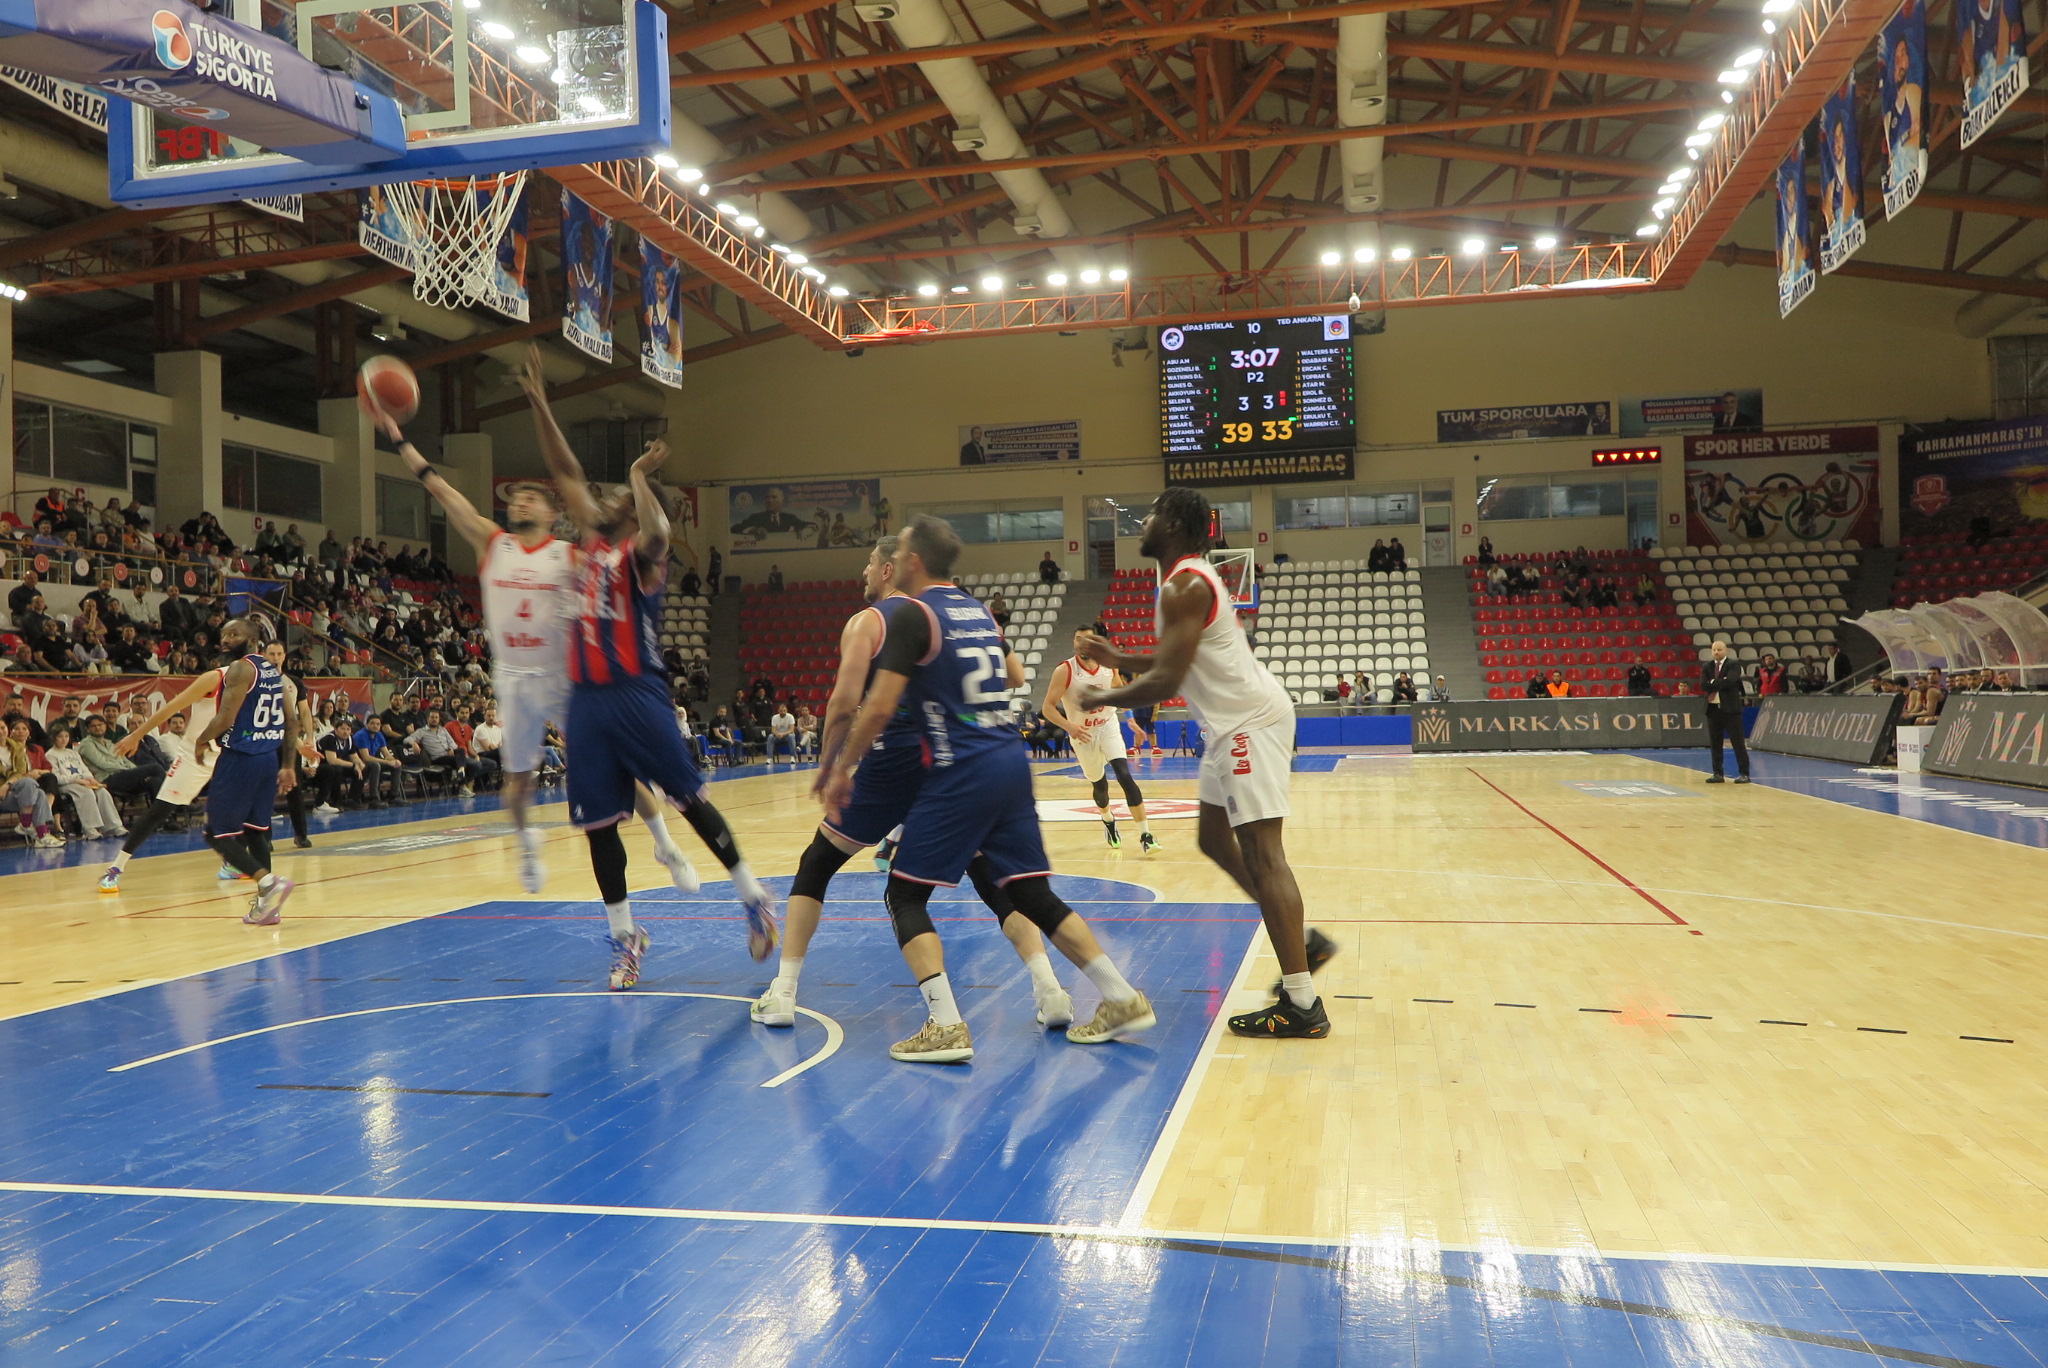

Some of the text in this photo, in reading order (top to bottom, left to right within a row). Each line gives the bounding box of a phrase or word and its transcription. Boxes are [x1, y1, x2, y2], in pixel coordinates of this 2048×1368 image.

[189, 22, 275, 75] TÜRKİYE
[195, 51, 278, 101] SİGORTA
[62, 88, 108, 128] SELEN
[1247, 323, 1261, 334] 10
[1292, 316, 1322, 324] ANKARA
[1230, 347, 1280, 369] 3:07
[1247, 372, 1265, 383] P2
[1238, 395, 1274, 411] 3 3
[1441, 410, 1475, 424] TÜM
[1479, 404, 1588, 422] SPORCULARA
[1222, 422, 1253, 443] 39
[1261, 420, 1293, 441] 33
[1694, 434, 1831, 456] SPOR HER YERDE
[1169, 453, 1347, 480] KAHRAMANMARAŞ
[1462, 524, 1472, 535] D
[1669, 514, 1680, 525] D
[1068, 542, 1079, 552] D
[1259, 532, 1268, 543] D
[1612, 712, 1703, 731] OTEL
[1833, 713, 1878, 744] OTEL
